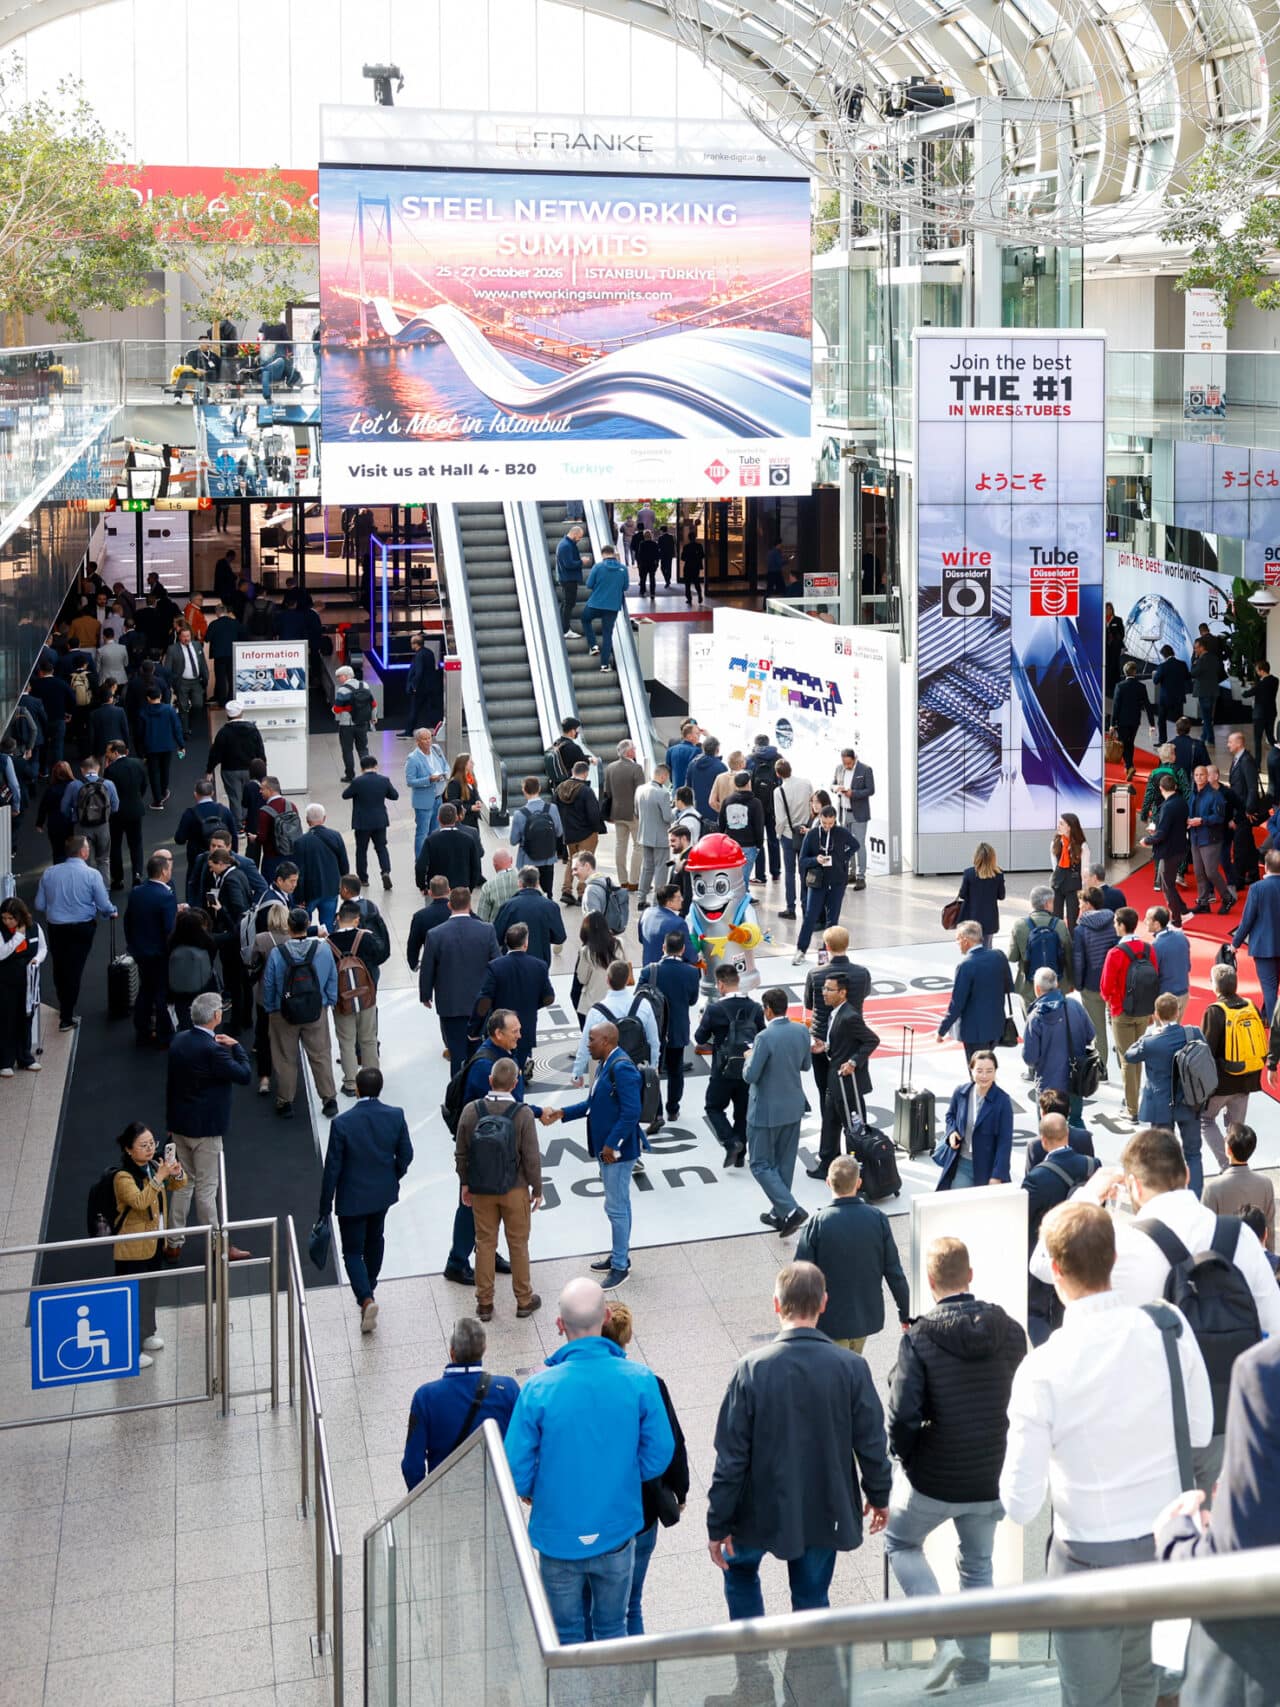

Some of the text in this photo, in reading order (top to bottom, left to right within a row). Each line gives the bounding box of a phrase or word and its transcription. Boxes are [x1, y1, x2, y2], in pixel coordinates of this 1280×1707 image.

[534, 132, 653, 152] FRANKE
[401, 196, 737, 226] STEEL NETWORKING
[498, 233, 649, 257] SUMMITS
[436, 266, 450, 277] 25
[462, 266, 477, 277] 27
[479, 266, 529, 278] October
[533, 267, 563, 279] 2026
[473, 288, 673, 302] www.networkingsummits.com
[950, 354, 1072, 370] Join the best
[950, 376, 1072, 401] THE #1
[949, 405, 1072, 416] IN WIRES&TUBES
[349, 411, 574, 434] Let's Meet in Istanbul
[740, 456, 760, 464] Tube
[349, 464, 387, 477] Visit
[393, 467, 413, 477] us
[418, 465, 435, 477] at
[441, 464, 473, 476] Hall
[478, 464, 489, 475] 4
[505, 463, 537, 475] B20
[975, 473, 1047, 491] ようこそ
[168, 502, 182, 511] 1-6
[942, 546, 1079, 566] wire Tube
[945, 570, 988, 578] Düsseldorf
[1033, 569, 1075, 577] Düsseldorf
[1165, 562, 1201, 583] worldwide
[242, 650, 299, 660] Information
